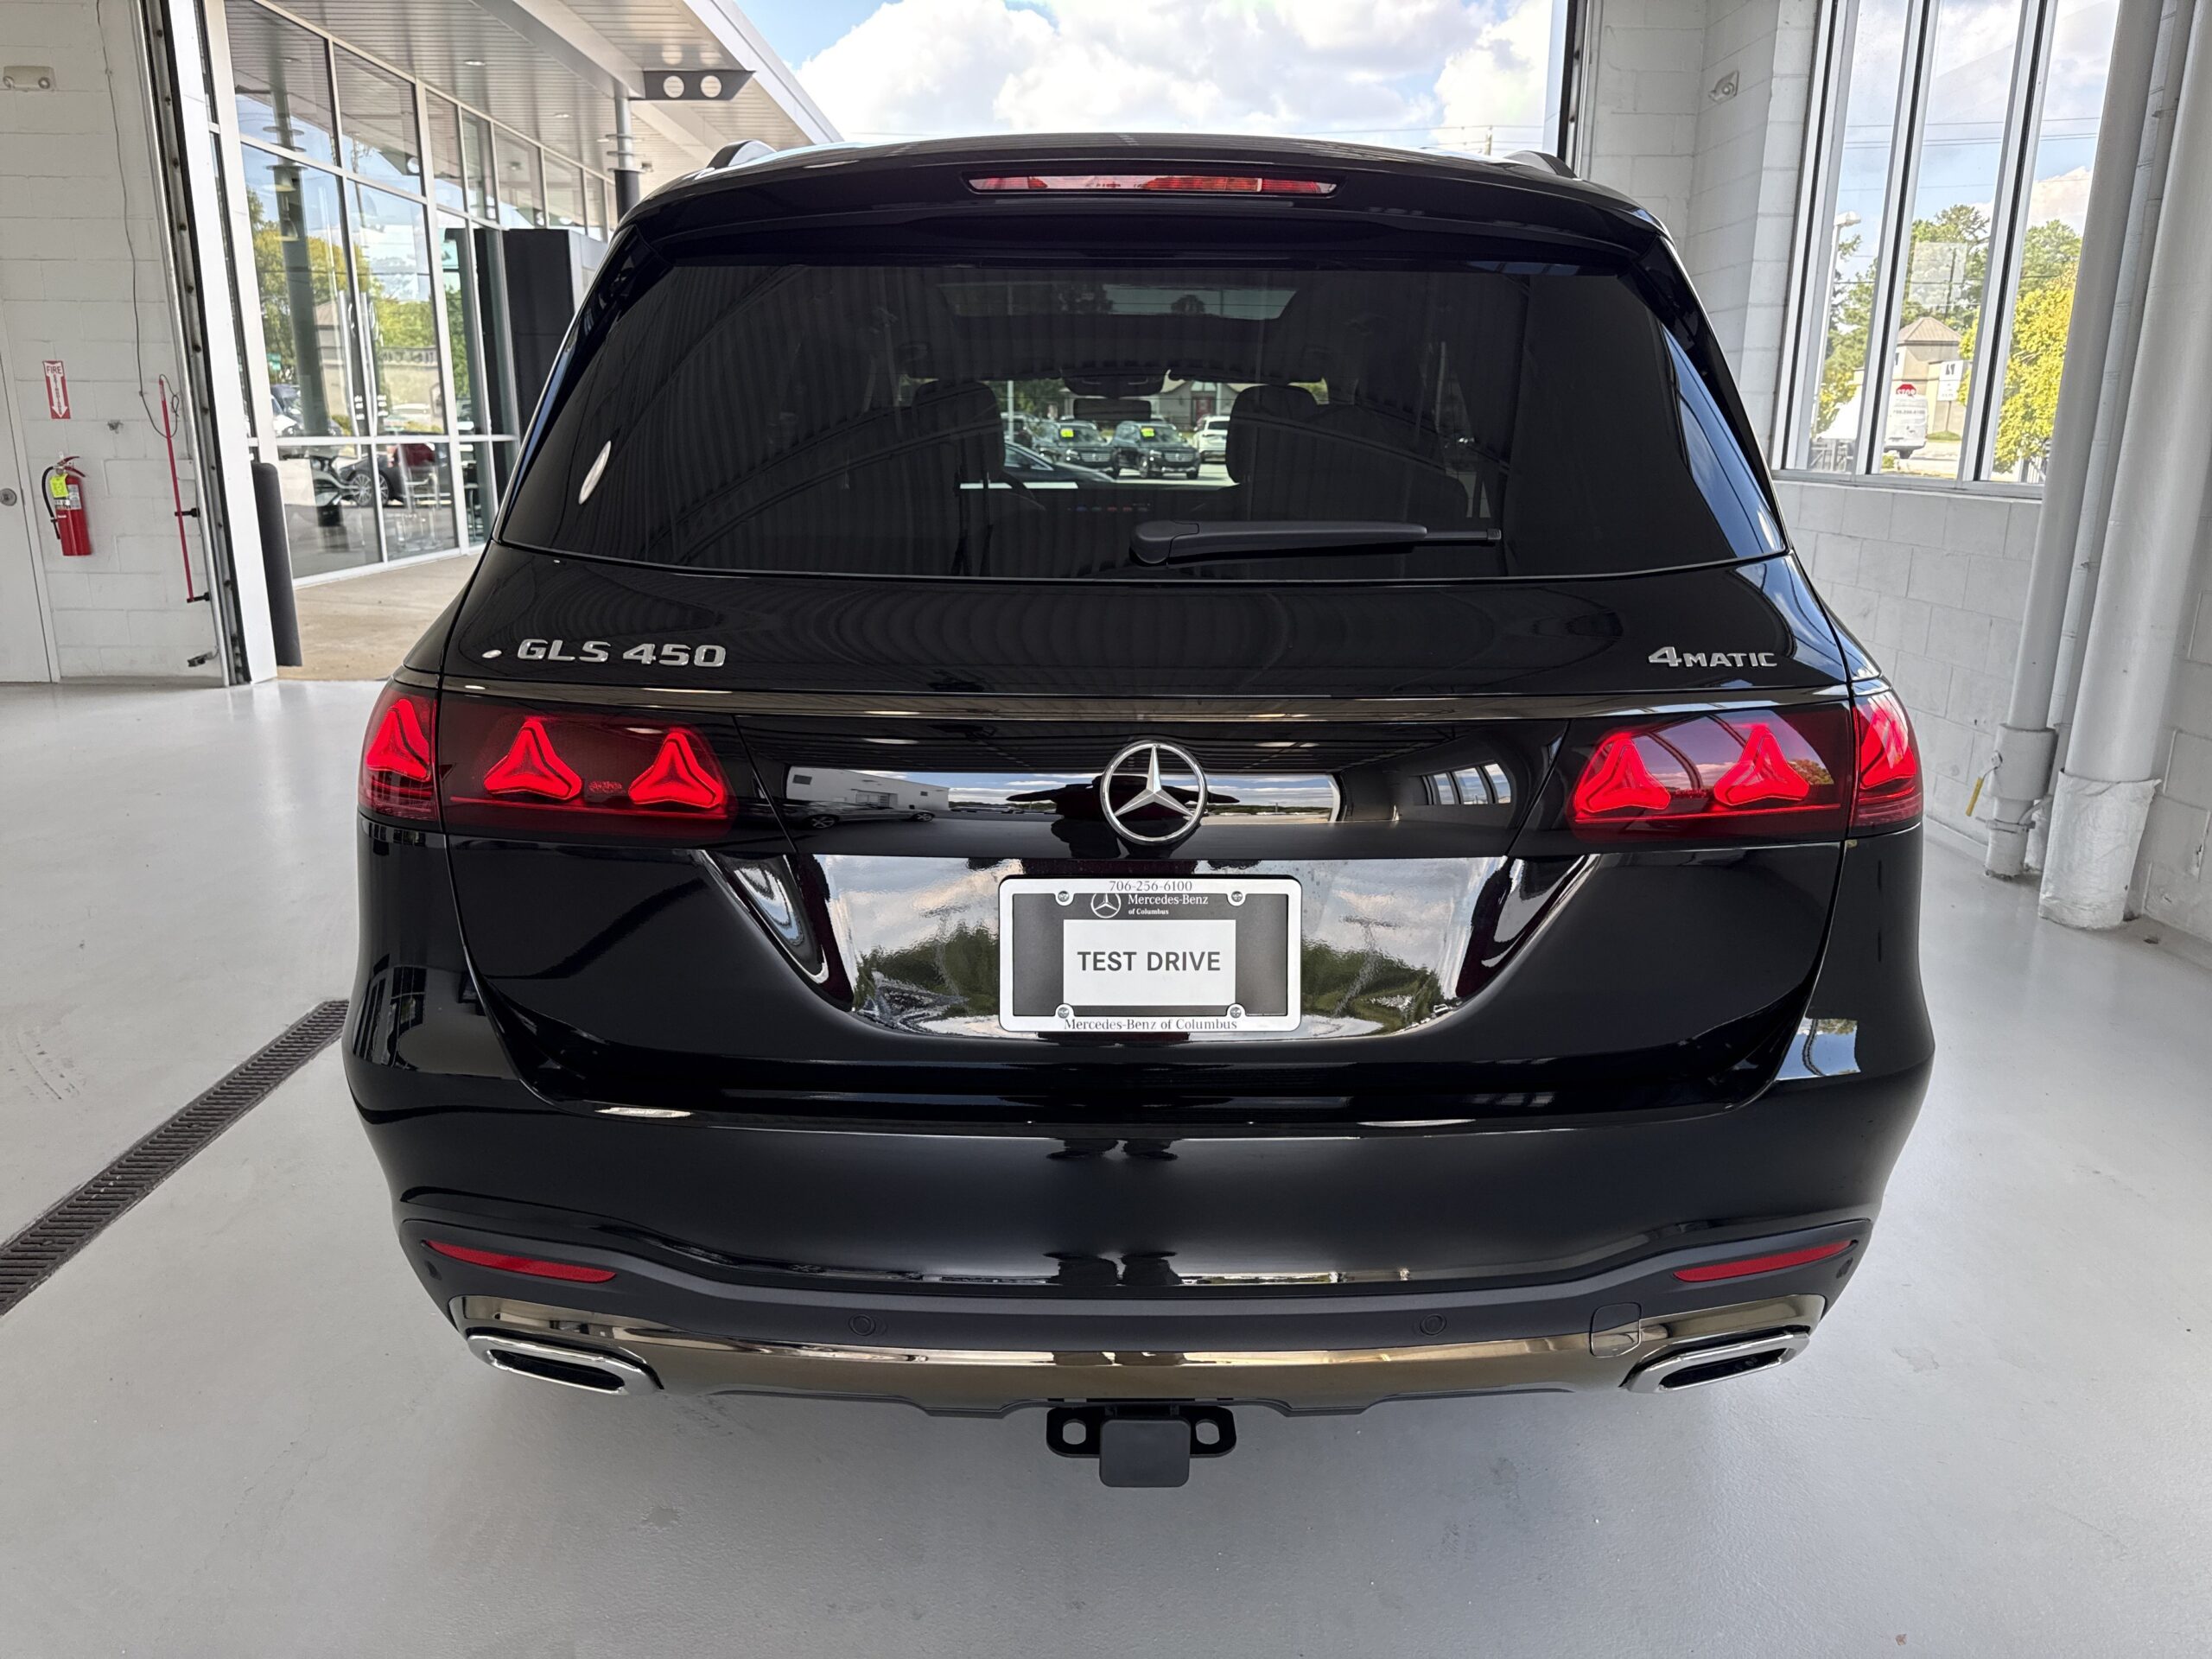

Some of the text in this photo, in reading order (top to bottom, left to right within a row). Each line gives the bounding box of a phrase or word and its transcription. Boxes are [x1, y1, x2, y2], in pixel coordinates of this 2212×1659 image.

[46, 365, 62, 374] FIRE
[518, 639, 727, 667] GLS 450
[1648, 646, 1777, 667] 4MATIC
[1109, 880, 1192, 892] 706-256-6100
[1128, 893, 1209, 905] Mercedes-Benz
[1077, 951, 1221, 971] TEST DRIVE
[1064, 1019, 1237, 1030] Mercedes-Benz of Columbus
